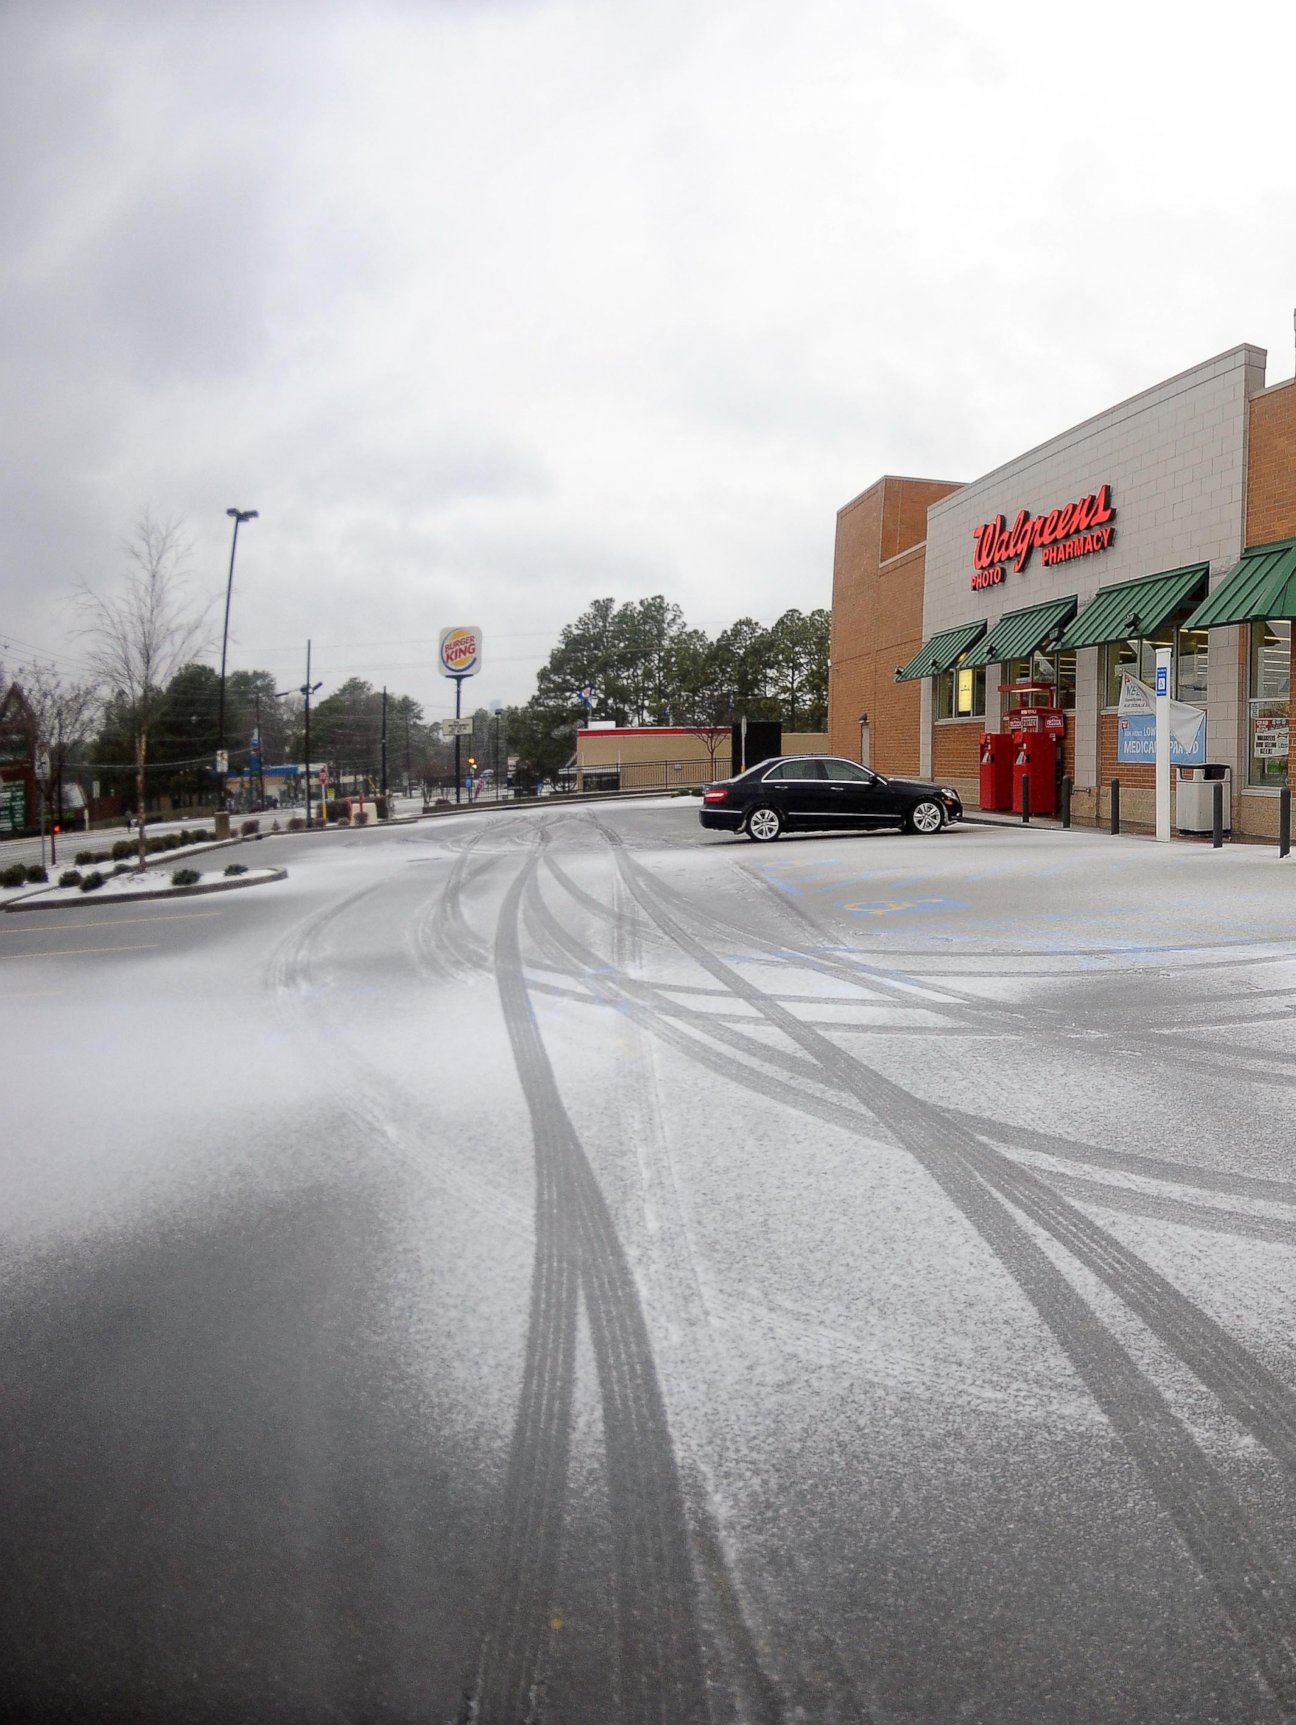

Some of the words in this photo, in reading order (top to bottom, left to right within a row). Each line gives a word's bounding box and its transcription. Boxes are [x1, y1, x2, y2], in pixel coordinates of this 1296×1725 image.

[973, 484, 1113, 573] Walgreens
[1041, 527, 1112, 566] PHARMACY
[970, 565, 1002, 591] PHOTO
[444, 635, 475, 654] BURGER
[445, 643, 476, 664] KING
[1124, 740, 1157, 753] MEDICA
[1169, 740, 1191, 754] PAR
